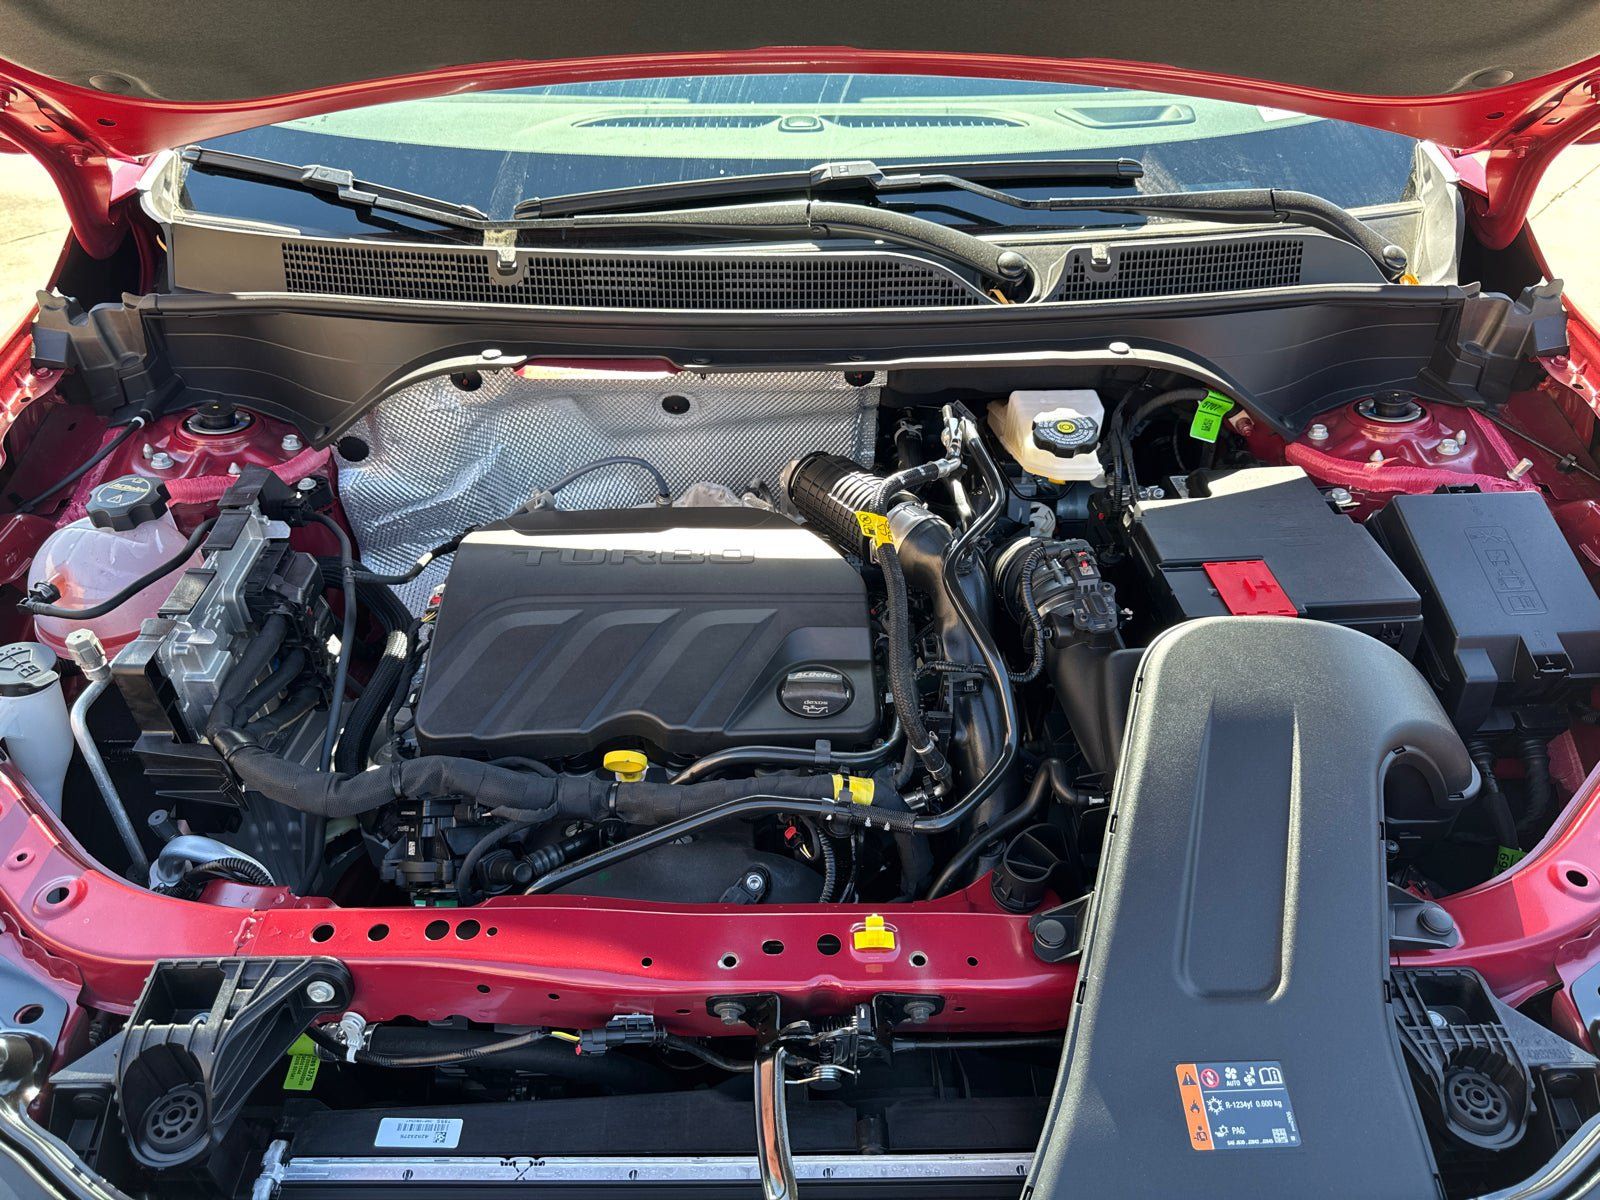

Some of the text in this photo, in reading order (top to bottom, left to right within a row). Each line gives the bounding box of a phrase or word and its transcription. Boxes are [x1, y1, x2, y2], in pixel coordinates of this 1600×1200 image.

[511, 548, 755, 567] TURBO
[794, 671, 838, 679] ACDelco
[1225, 1099, 1283, 1110] R-1234yf 0.600 kg
[1231, 1126, 1246, 1135] PAG
